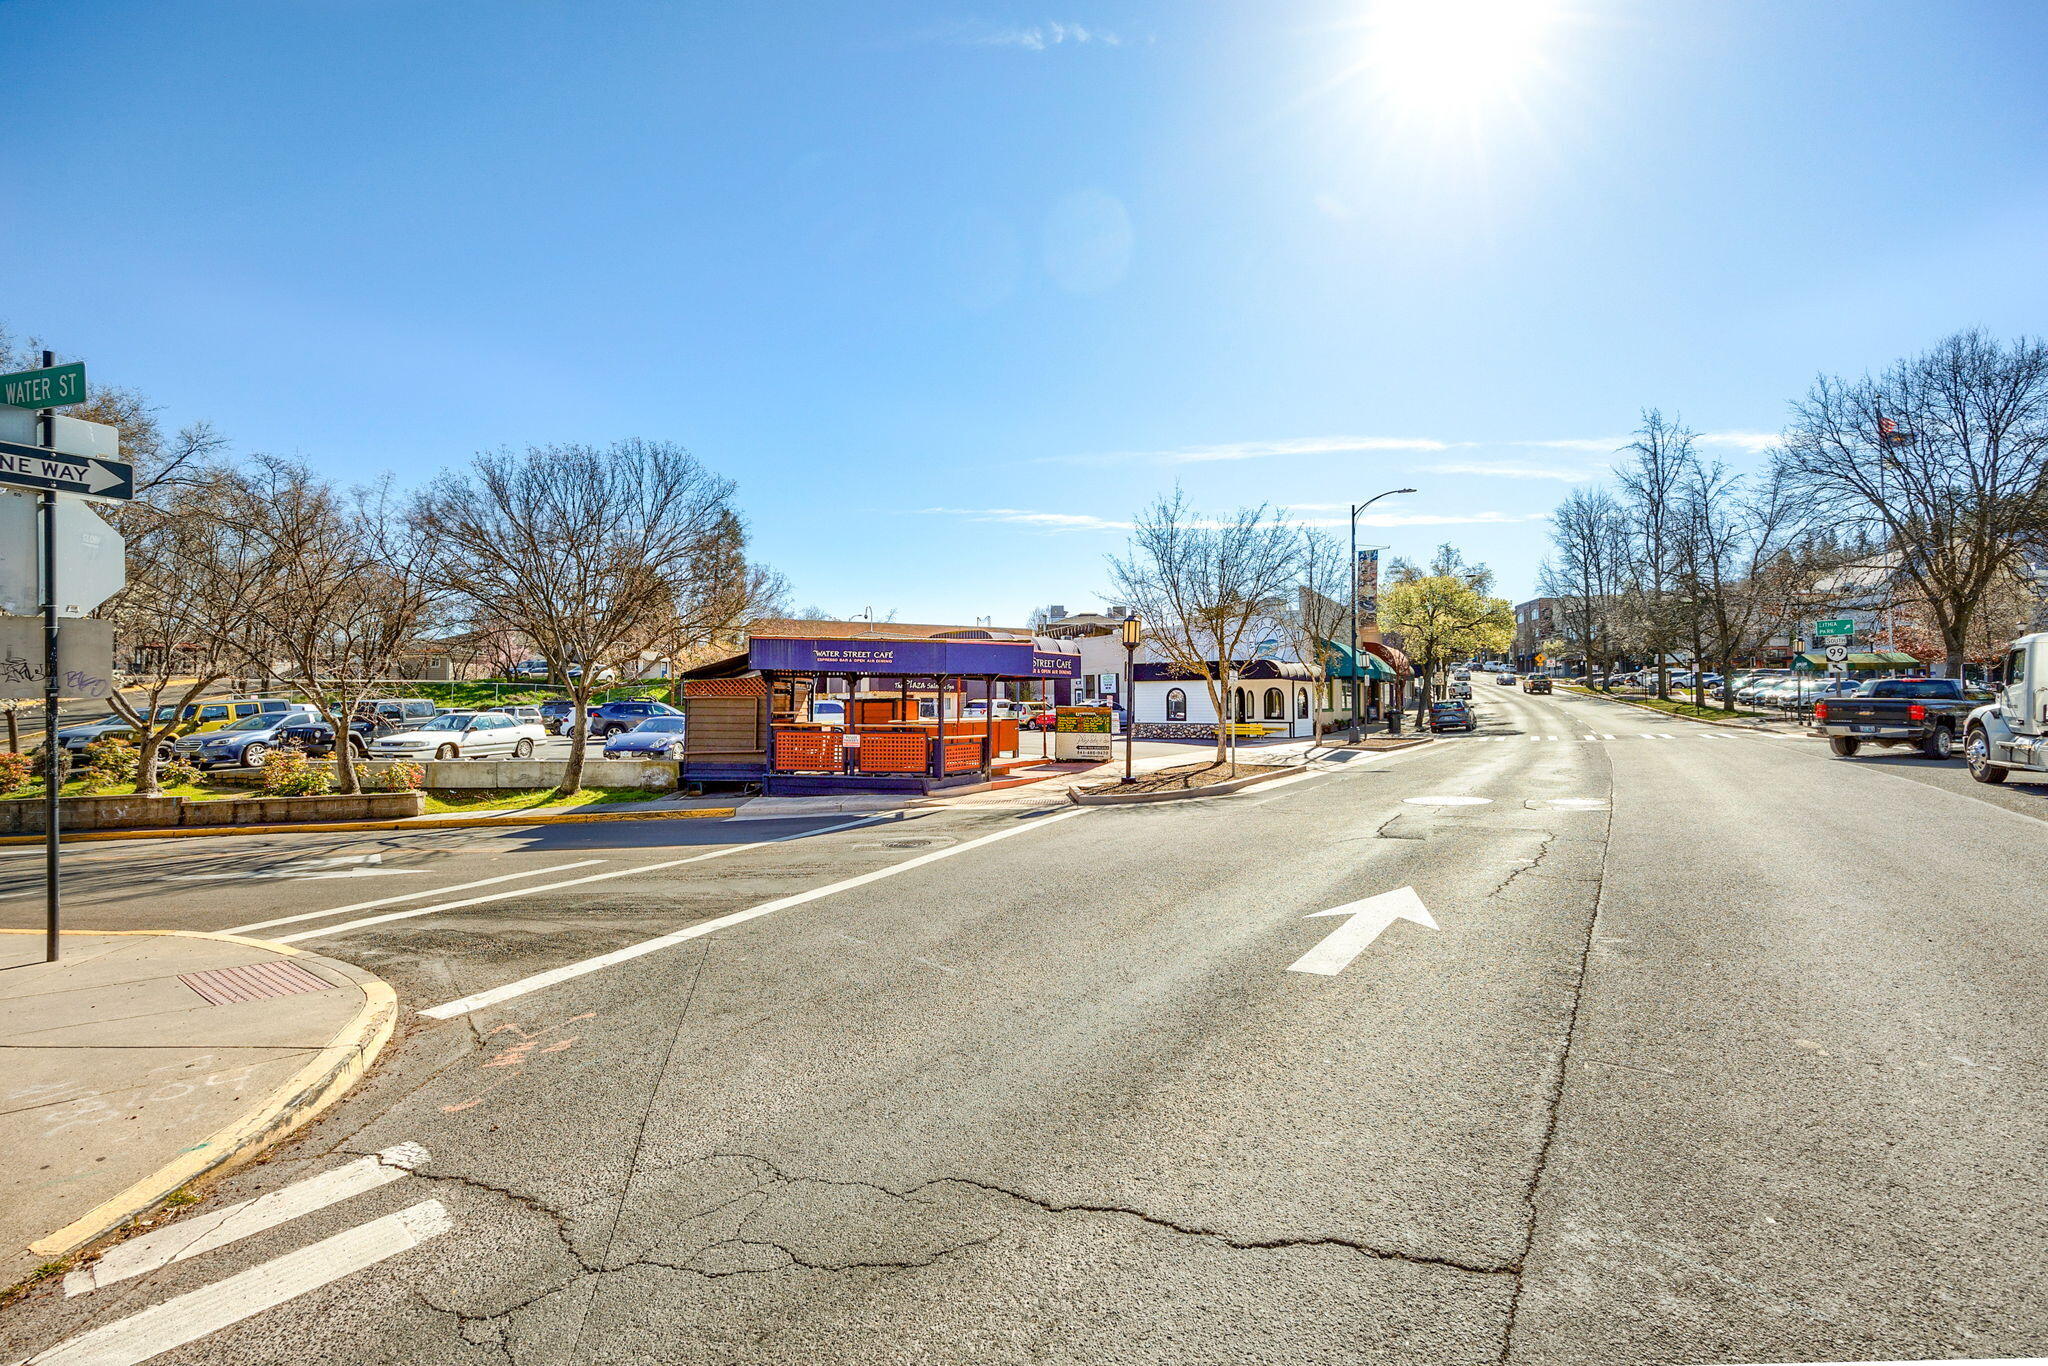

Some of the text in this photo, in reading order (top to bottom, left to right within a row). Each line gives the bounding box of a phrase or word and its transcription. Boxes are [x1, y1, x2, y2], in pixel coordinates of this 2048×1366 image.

[5, 373, 77, 405] WATER ST
[0, 454, 89, 482] NE WAY
[843, 650, 871, 658] STREET
[873, 651, 894, 659] CAFÉ
[1829, 648, 1844, 657] 99
[1056, 658, 1072, 669] CAFÉ
